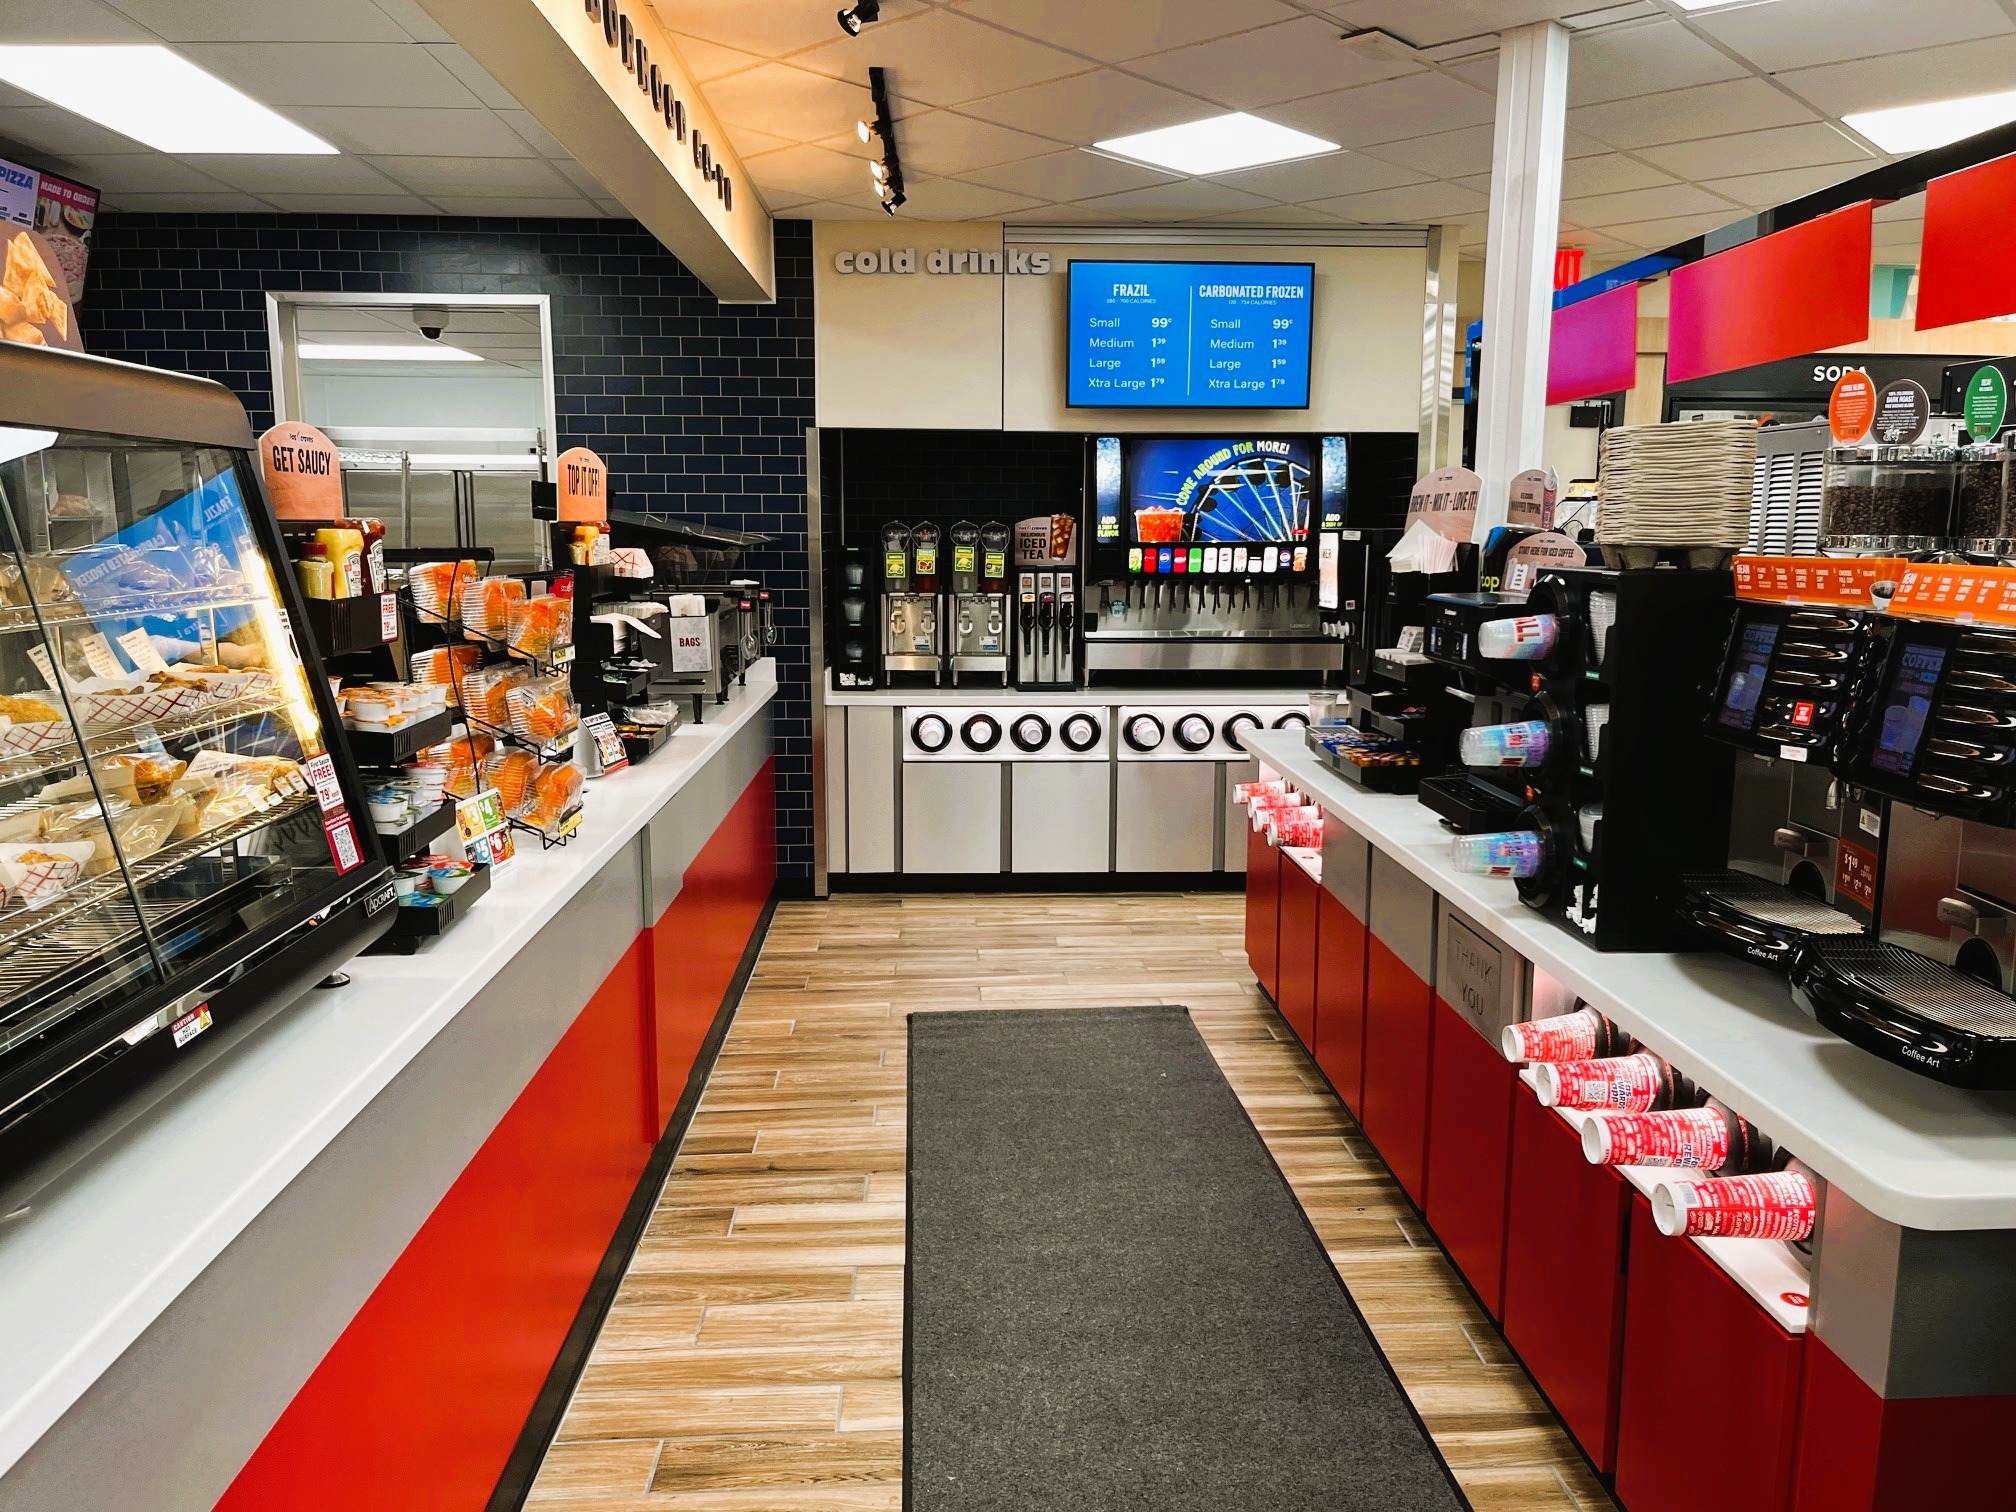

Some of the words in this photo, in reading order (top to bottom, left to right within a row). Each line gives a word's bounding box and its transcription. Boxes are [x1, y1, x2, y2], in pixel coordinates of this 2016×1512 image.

[41, 181, 62, 196] MADE
[63, 188, 72, 199] TO
[73, 193, 96, 207] ORDER
[834, 248, 916, 275] cold
[926, 248, 1050, 276] drinks
[1554, 250, 1584, 290] XIT
[1113, 283, 1150, 297] FRAZIL
[1199, 284, 1264, 298] CARBONATED
[1265, 285, 1304, 299] FROZEN
[1089, 317, 1120, 328] Small
[1210, 318, 1241, 329] Small
[1089, 337, 1134, 348] Medium
[1210, 338, 1255, 349] Medium
[1089, 358, 1121, 370] Large
[1209, 359, 1242, 371] Large
[1088, 377, 1111, 388] Xtra
[1114, 378, 1146, 390] Large
[1208, 378, 1231, 389] Xtra
[1233, 379, 1266, 391] Large
[1898, 395, 1915, 403] ROAST
[272, 445, 294, 473] GET
[297, 448, 331, 476] SAUCY
[1176, 476, 1198, 506] COME
[1193, 448, 1231, 480] AROUND
[1232, 441, 1254, 457] FOR
[1256, 440, 1290, 455] MORE!
[567, 464, 580, 496] TOP
[581, 466, 587, 496] IT
[588, 467, 600, 498] OFF!
[1409, 494, 1425, 513] BREW
[1422, 493, 1431, 513] IT
[1431, 492, 1445, 512] MIX
[1441, 492, 1450, 512] IT
[1452, 491, 1469, 511] LOVE
[1101, 516, 1116, 525] ADD
[1325, 513, 1340, 522] ADD
[1019, 538, 1047, 549] ICED
[1021, 549, 1044, 560] TEA
[1518, 546, 1530, 555] START
[1530, 546, 1540, 556] HERE
[1558, 548, 1574, 558] COFFEE
[1736, 564, 1750, 574] BEAN
[1737, 574, 1743, 582] TO
[1743, 574, 1751, 582] CUP
[1902, 573, 1918, 584] BEAN
[679, 637, 701, 648] BAGS
[1902, 652, 1942, 671] COFFEE
[310, 760, 319, 768] First
[318, 758, 330, 766] Sauce
[313, 764, 335, 781] FREE!
[465, 804, 480, 823] $3
[480, 798, 493, 816] $4
[476, 839, 490, 859] $5
[489, 832, 502, 852] $6
[1747, 946, 1766, 959] Coffee
[1766, 951, 1778, 962] Art
[1455, 939, 1493, 986] THANK
[1461, 982, 1484, 1016] YOU
[173, 1013, 195, 1031] CAUTION
[179, 1027, 197, 1044] SURFACE
[1901, 1045, 1926, 1062] Coffee
[1926, 1055, 1940, 1068] Art
